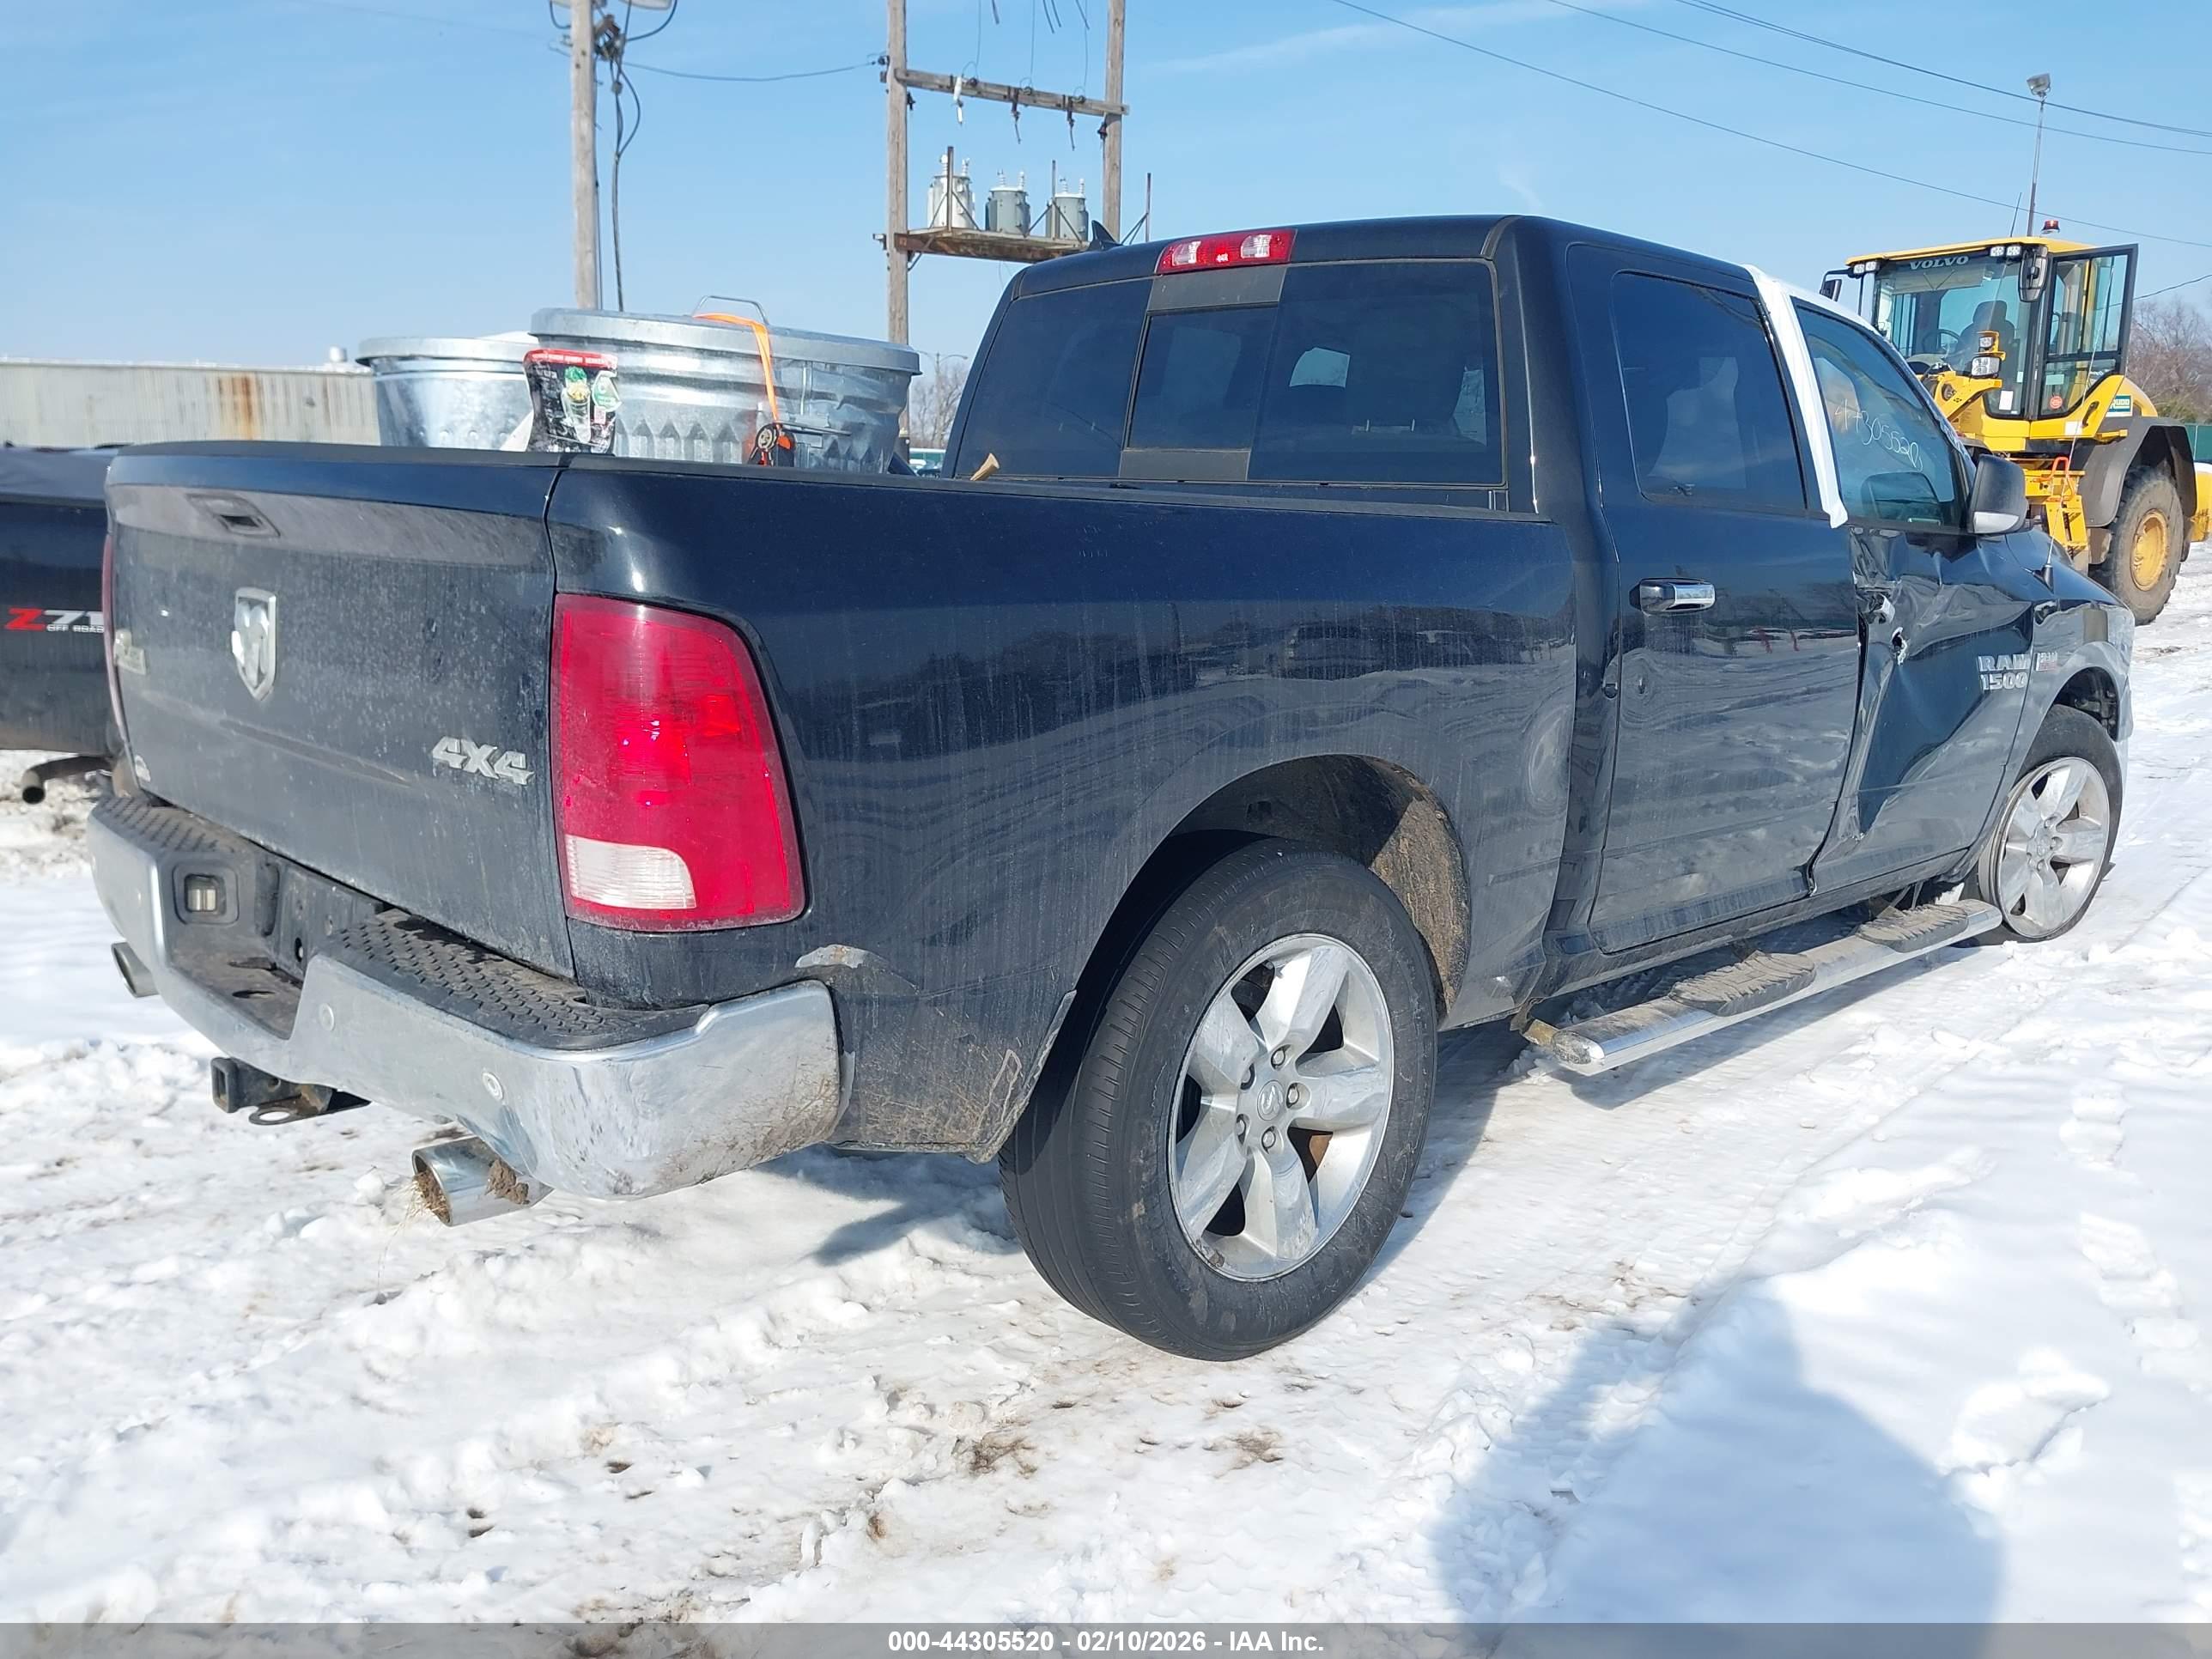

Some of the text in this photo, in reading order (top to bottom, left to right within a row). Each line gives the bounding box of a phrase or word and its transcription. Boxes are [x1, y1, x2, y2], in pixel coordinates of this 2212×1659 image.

[1910, 256, 1969, 270] VOLVO
[1978, 653, 2031, 672] RAM
[1980, 672, 2027, 690] 1500
